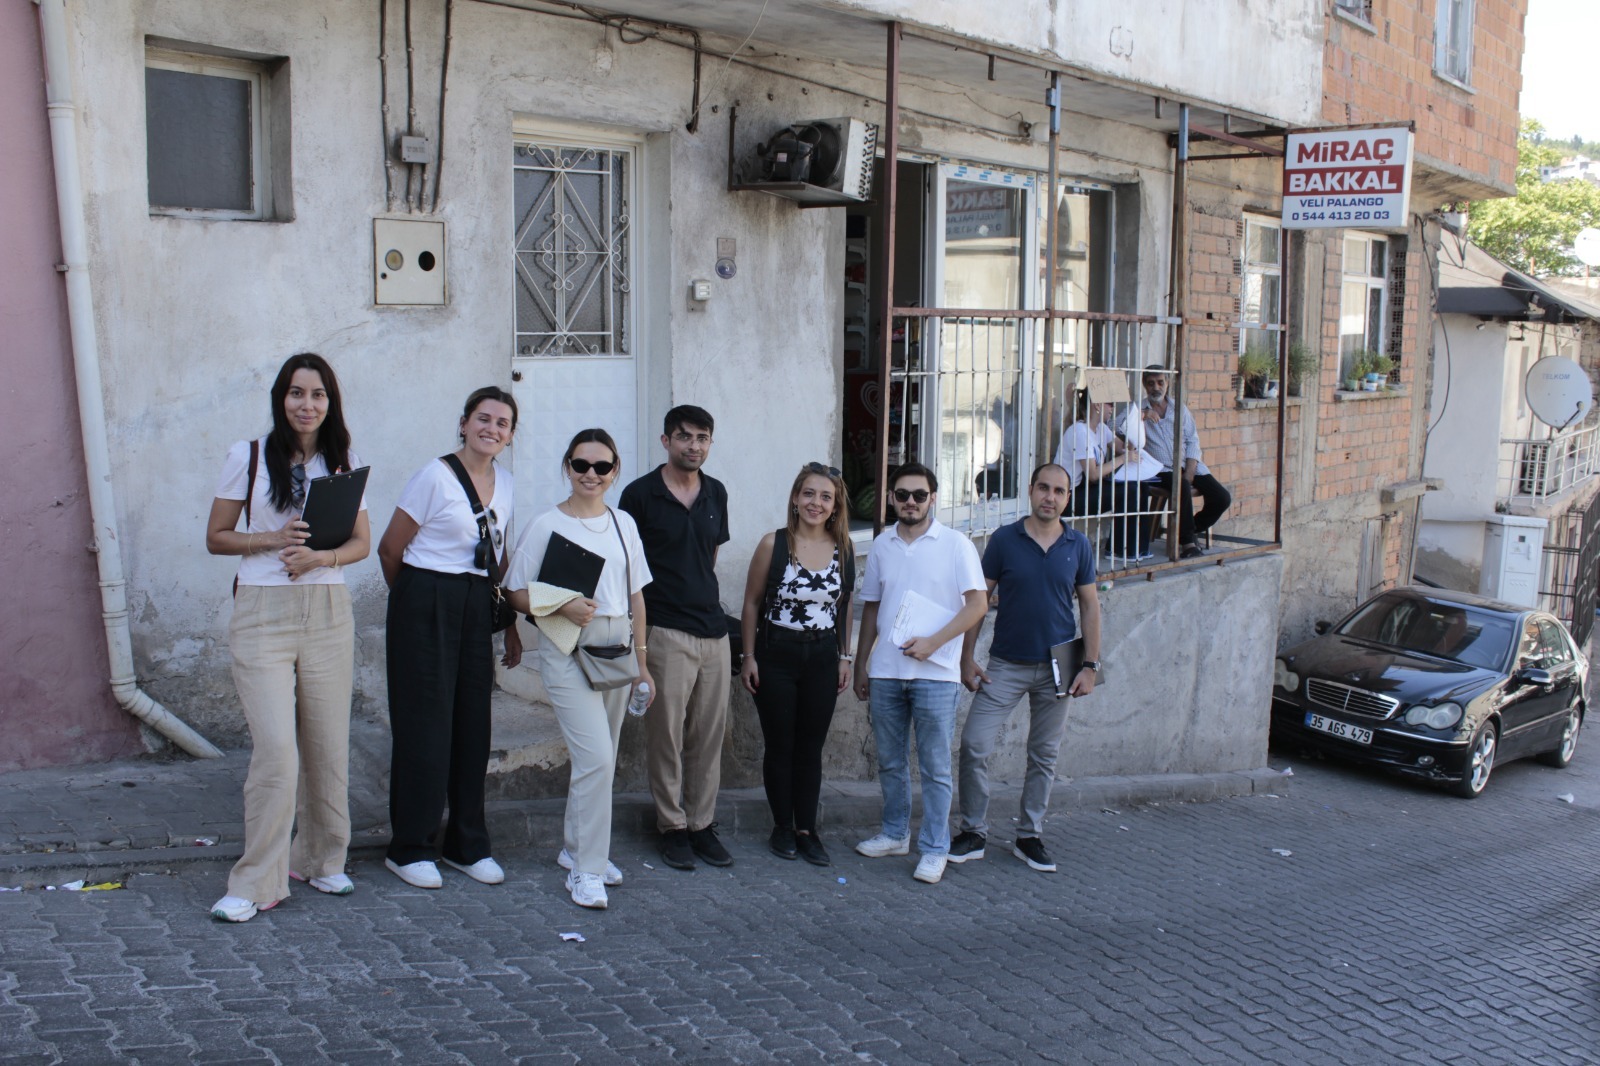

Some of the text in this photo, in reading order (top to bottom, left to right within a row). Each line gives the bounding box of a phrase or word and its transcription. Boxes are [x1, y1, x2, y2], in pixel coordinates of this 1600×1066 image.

[1290, 171, 1397, 192] BAKKAL
[1327, 197, 1384, 207] PALANGO
[1292, 210, 1390, 221] 0 544 413 20 03
[1311, 715, 1324, 728] 35
[1327, 720, 1346, 736] AGS
[1351, 727, 1371, 743] 479
